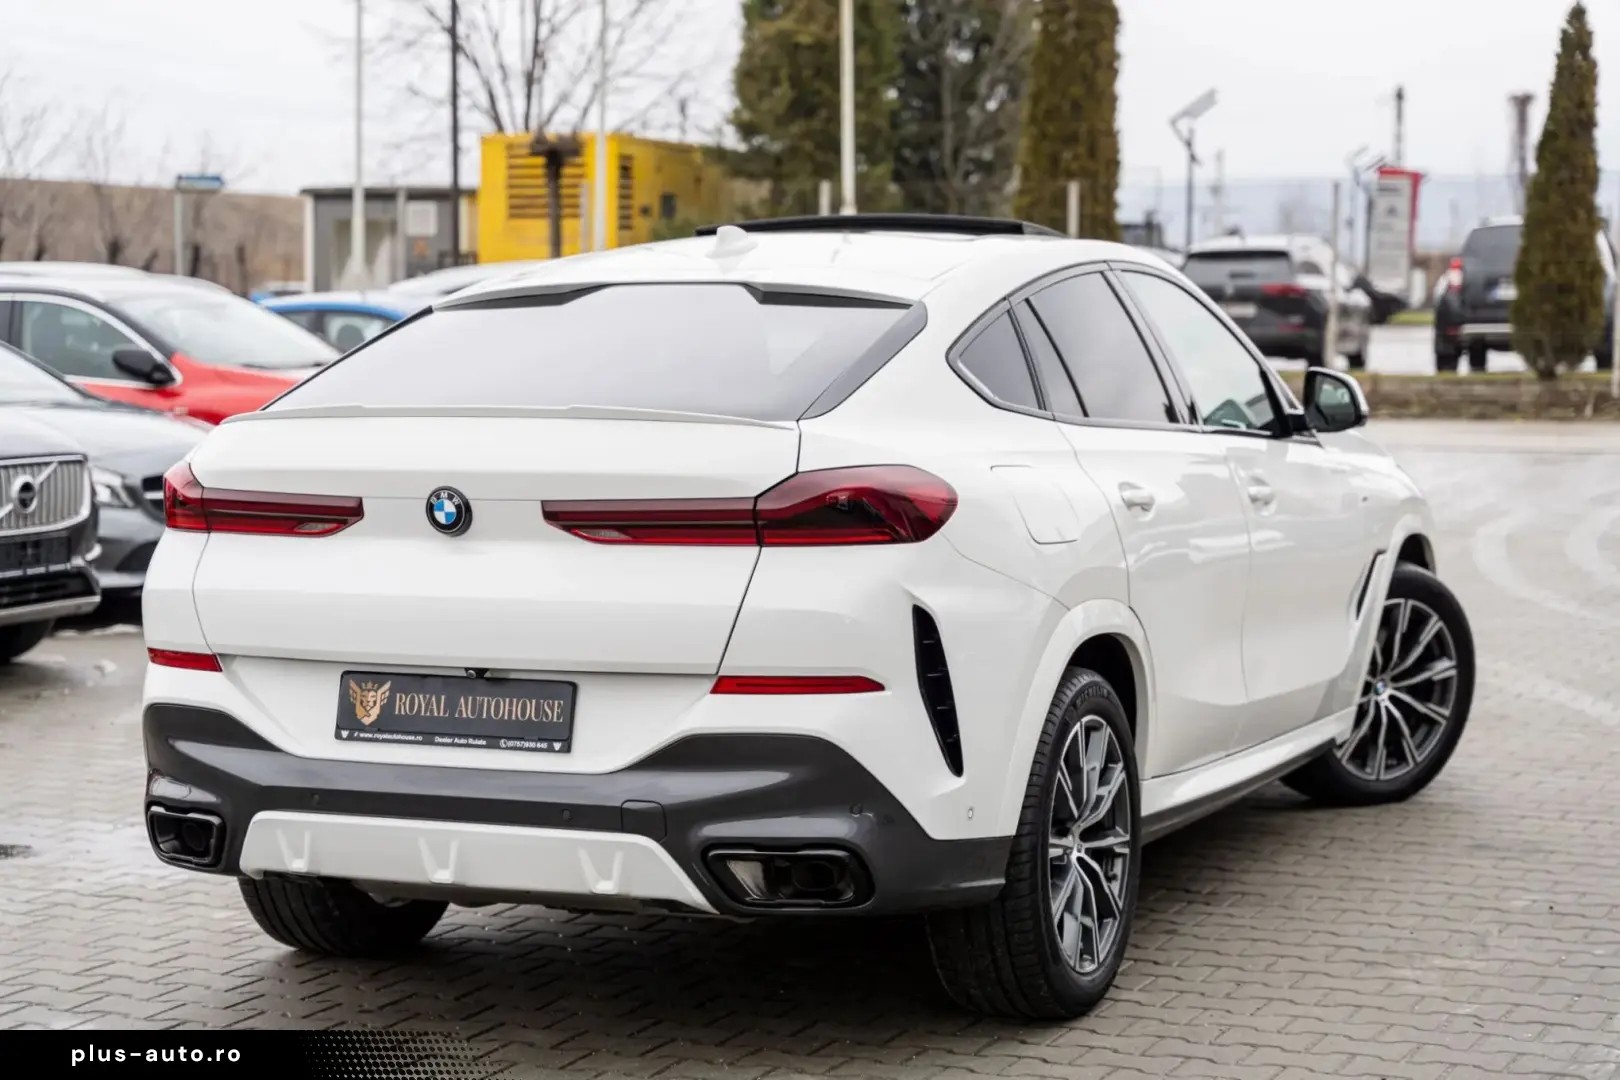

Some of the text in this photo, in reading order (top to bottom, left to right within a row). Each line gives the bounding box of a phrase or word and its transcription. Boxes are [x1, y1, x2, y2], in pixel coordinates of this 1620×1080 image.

[430, 491, 460, 505] BMW
[395, 693, 564, 723] ROYAL AUTOHOUSE
[434, 736, 487, 746] Dealer Auto Rulate
